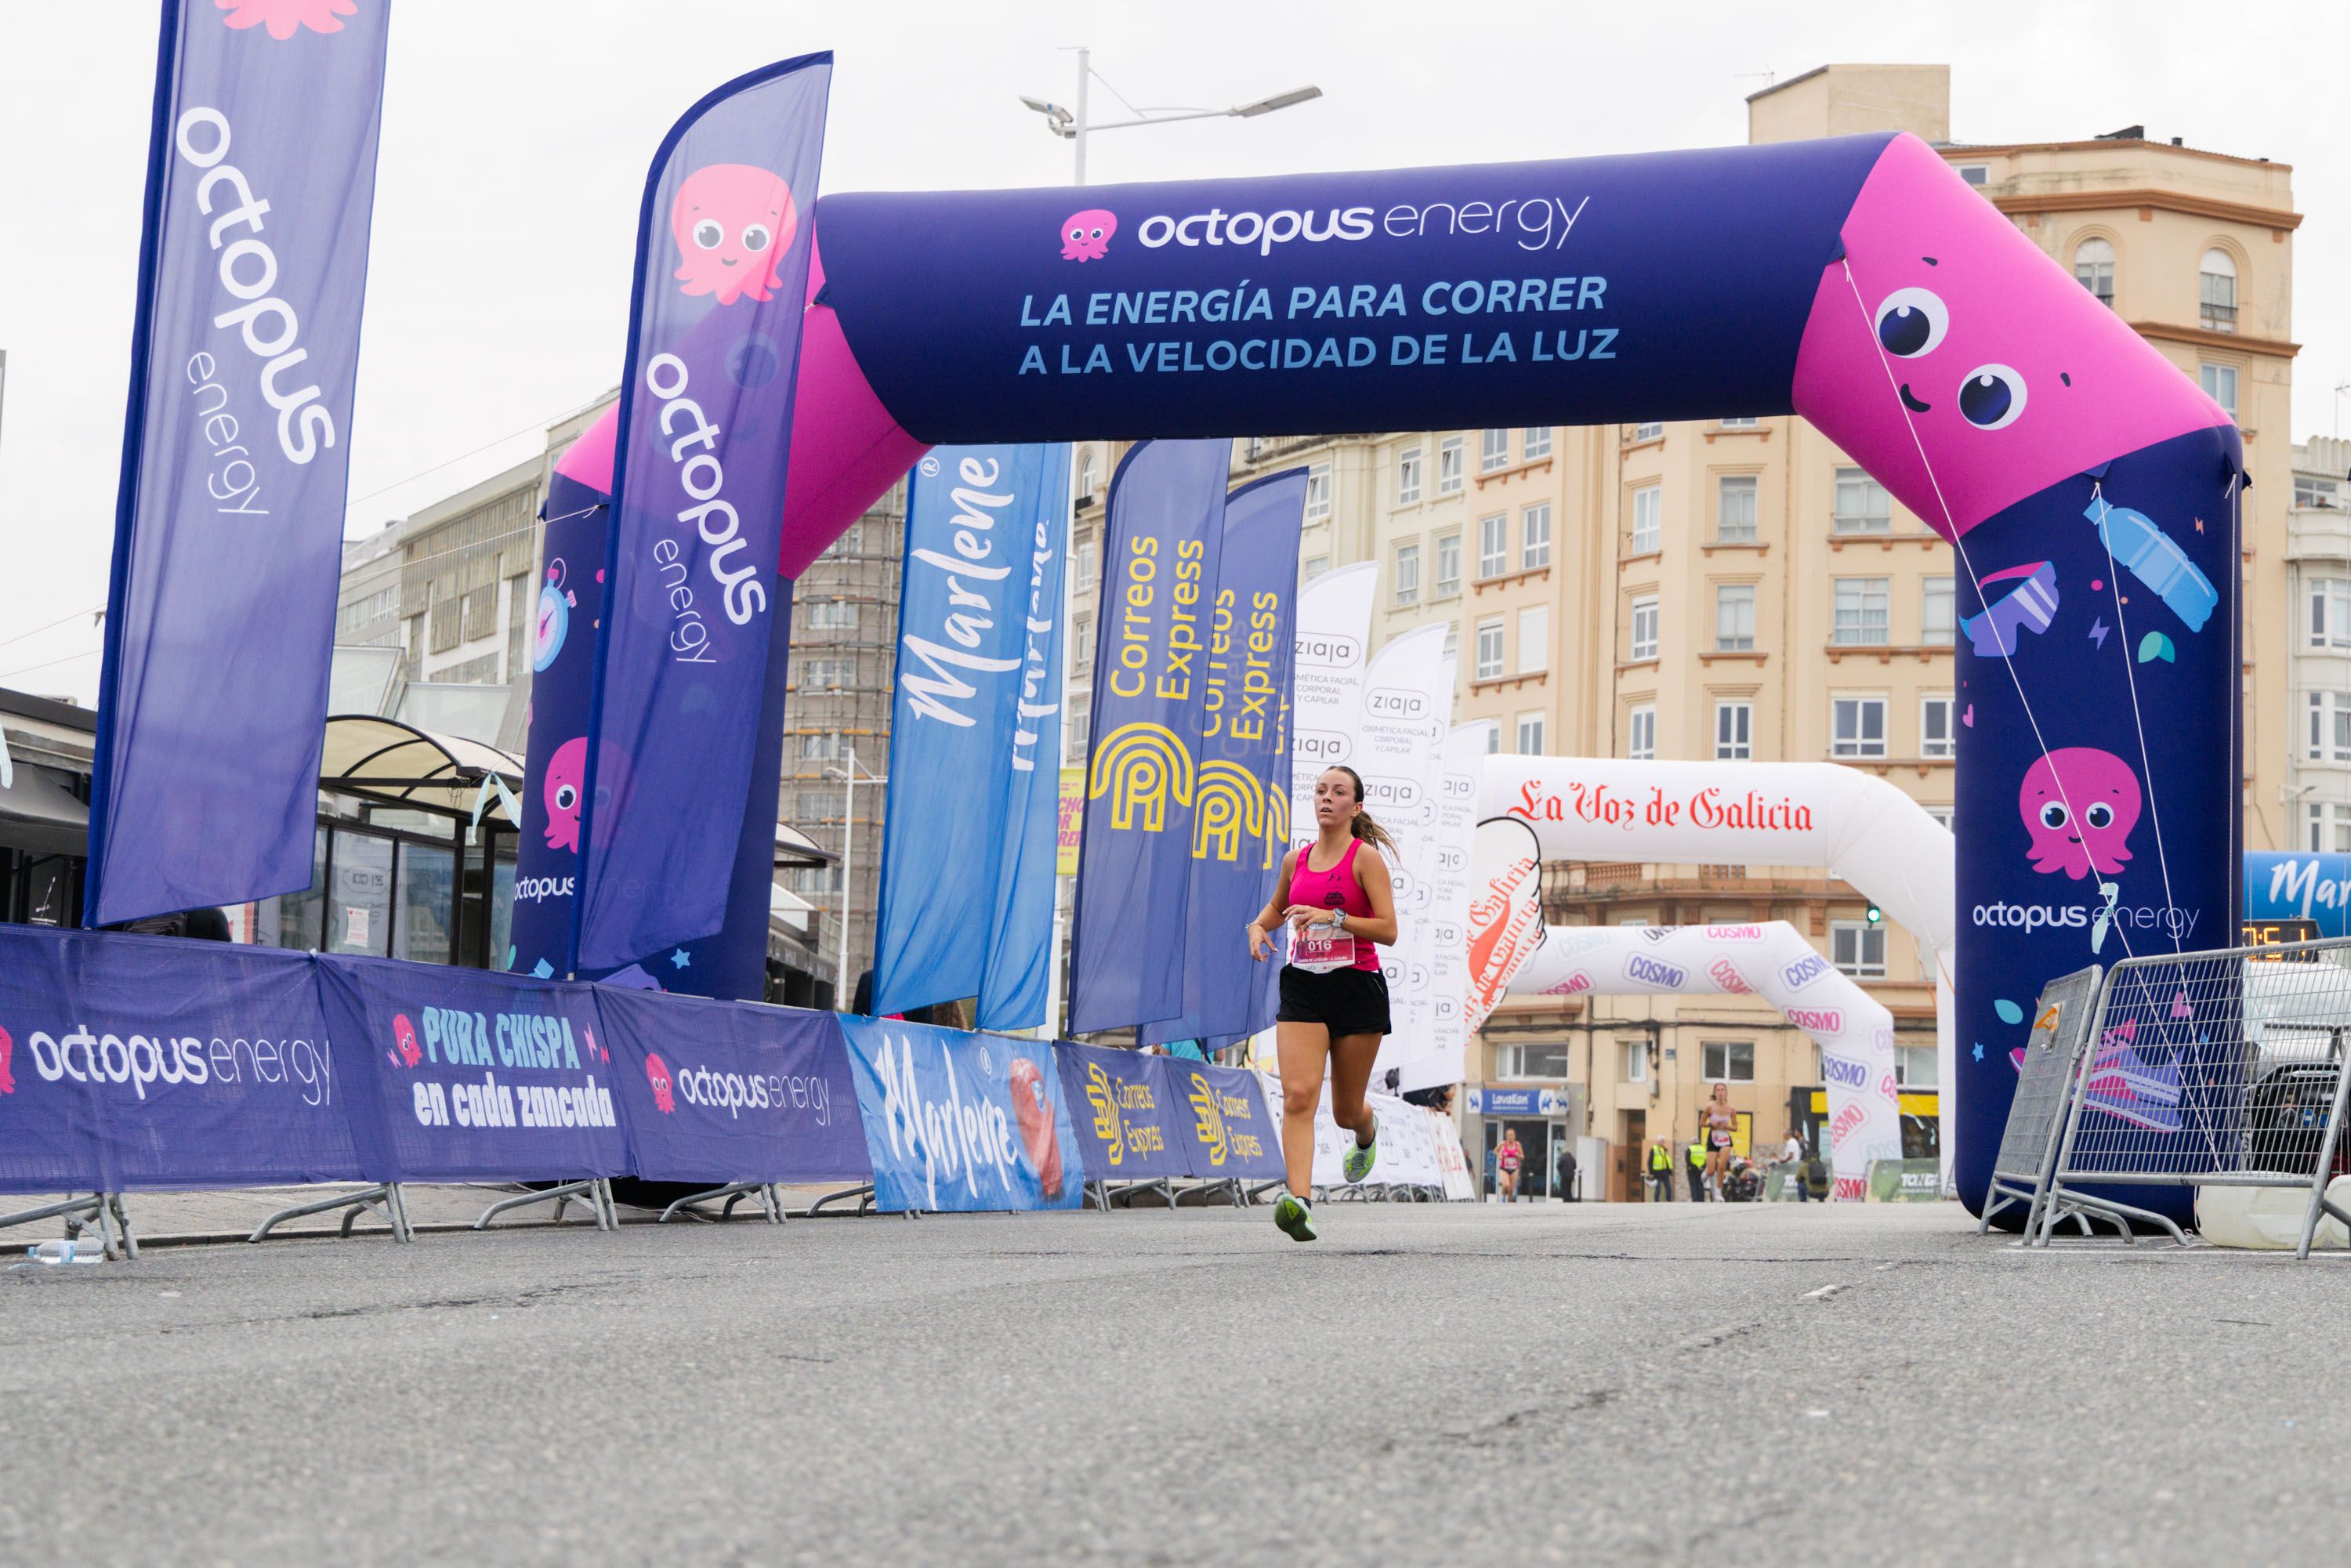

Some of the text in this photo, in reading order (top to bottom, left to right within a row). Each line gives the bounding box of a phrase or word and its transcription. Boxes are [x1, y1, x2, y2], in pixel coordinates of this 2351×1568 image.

[1137, 196, 1591, 256] octopus energy
[176, 107, 335, 465] octopus
[1020, 275, 1608, 328] LA ENERGÍA PARA CORRER
[1018, 328, 1620, 375] A LA VELOCIDAD DE LA LUZ
[187, 351, 270, 514] energy
[647, 353, 766, 625] octopus
[654, 539, 717, 663] energy
[900, 456, 1022, 727] Marlene
[1110, 535, 1159, 697] Correos
[1156, 539, 1204, 701] Express
[1230, 592, 1278, 741] Express
[1295, 673, 1360, 686] MÉTICA FACIAL
[1296, 684, 1342, 695] CORPORAL
[1304, 695, 1339, 705] CAPILAR
[1373, 696, 1421, 715] ziaja
[1364, 784, 1411, 803] ziaja
[1506, 780, 1814, 831] La Voz de Galicia
[1309, 940, 1332, 951] 016
[1973, 901, 2200, 939] octopus energy
[1629, 955, 1683, 988] COSMO
[1710, 960, 1755, 995] COSM
[422, 1005, 581, 1070] PURA CHISPA
[1788, 1009, 1840, 1032] COSMO
[29, 1024, 331, 1106] octopus energy
[414, 1072, 616, 1127] en cada zancada
[679, 1064, 830, 1126] octopus energy
[875, 1034, 1019, 1211] Marlene
